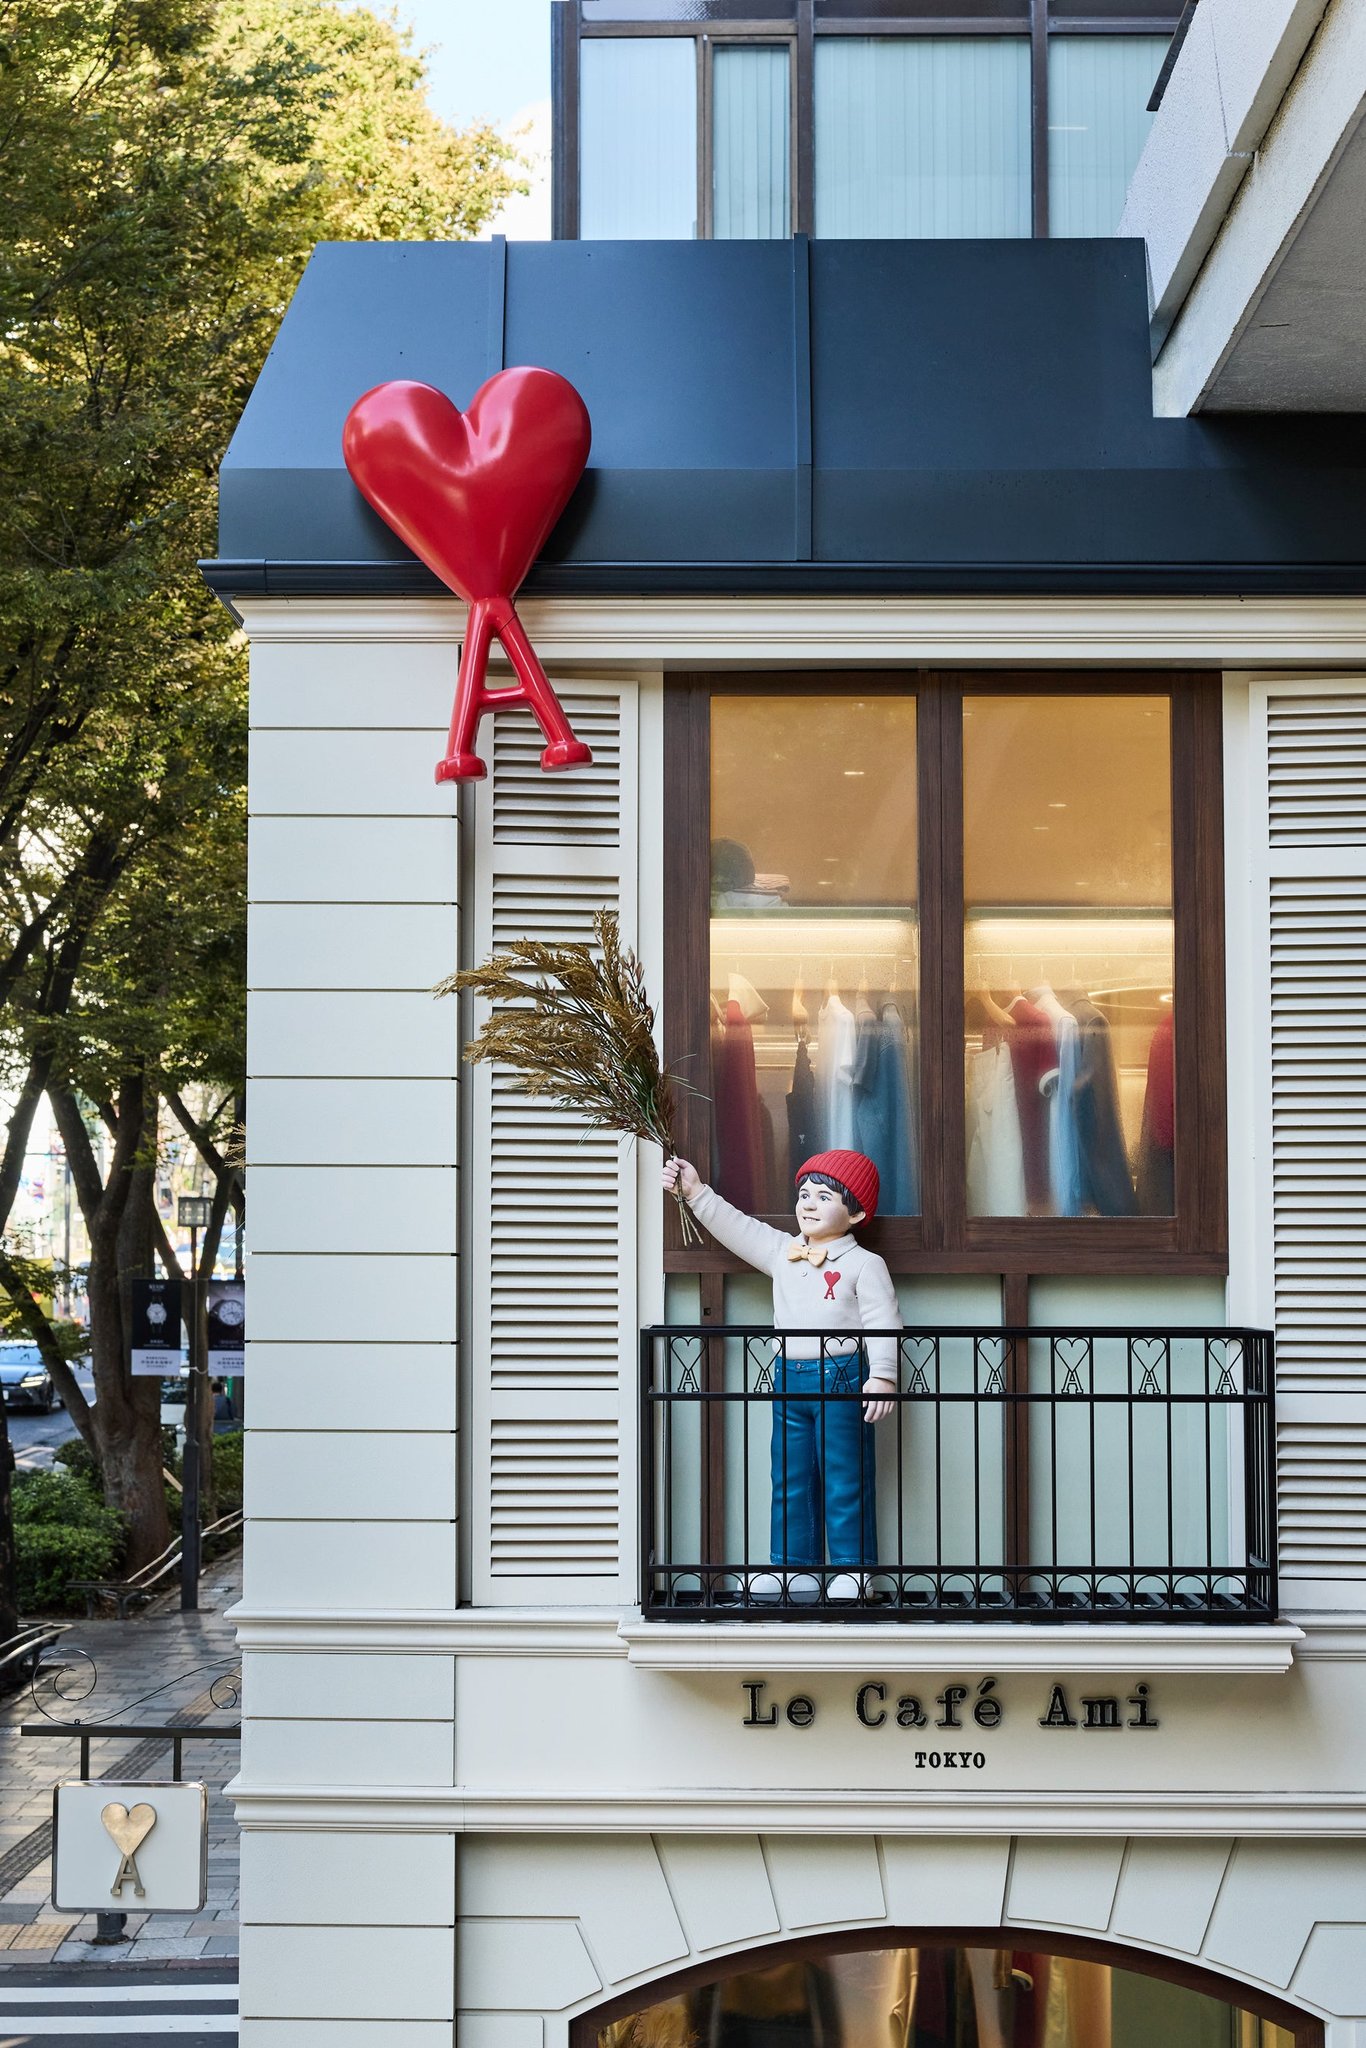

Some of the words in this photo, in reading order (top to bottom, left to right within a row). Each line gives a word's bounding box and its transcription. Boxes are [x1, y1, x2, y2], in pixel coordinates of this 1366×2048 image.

[740, 1679, 817, 1729] Le
[855, 1676, 1004, 1729] Café
[1038, 1680, 1160, 1730] Ami
[914, 1751, 987, 1769] TOKYO
